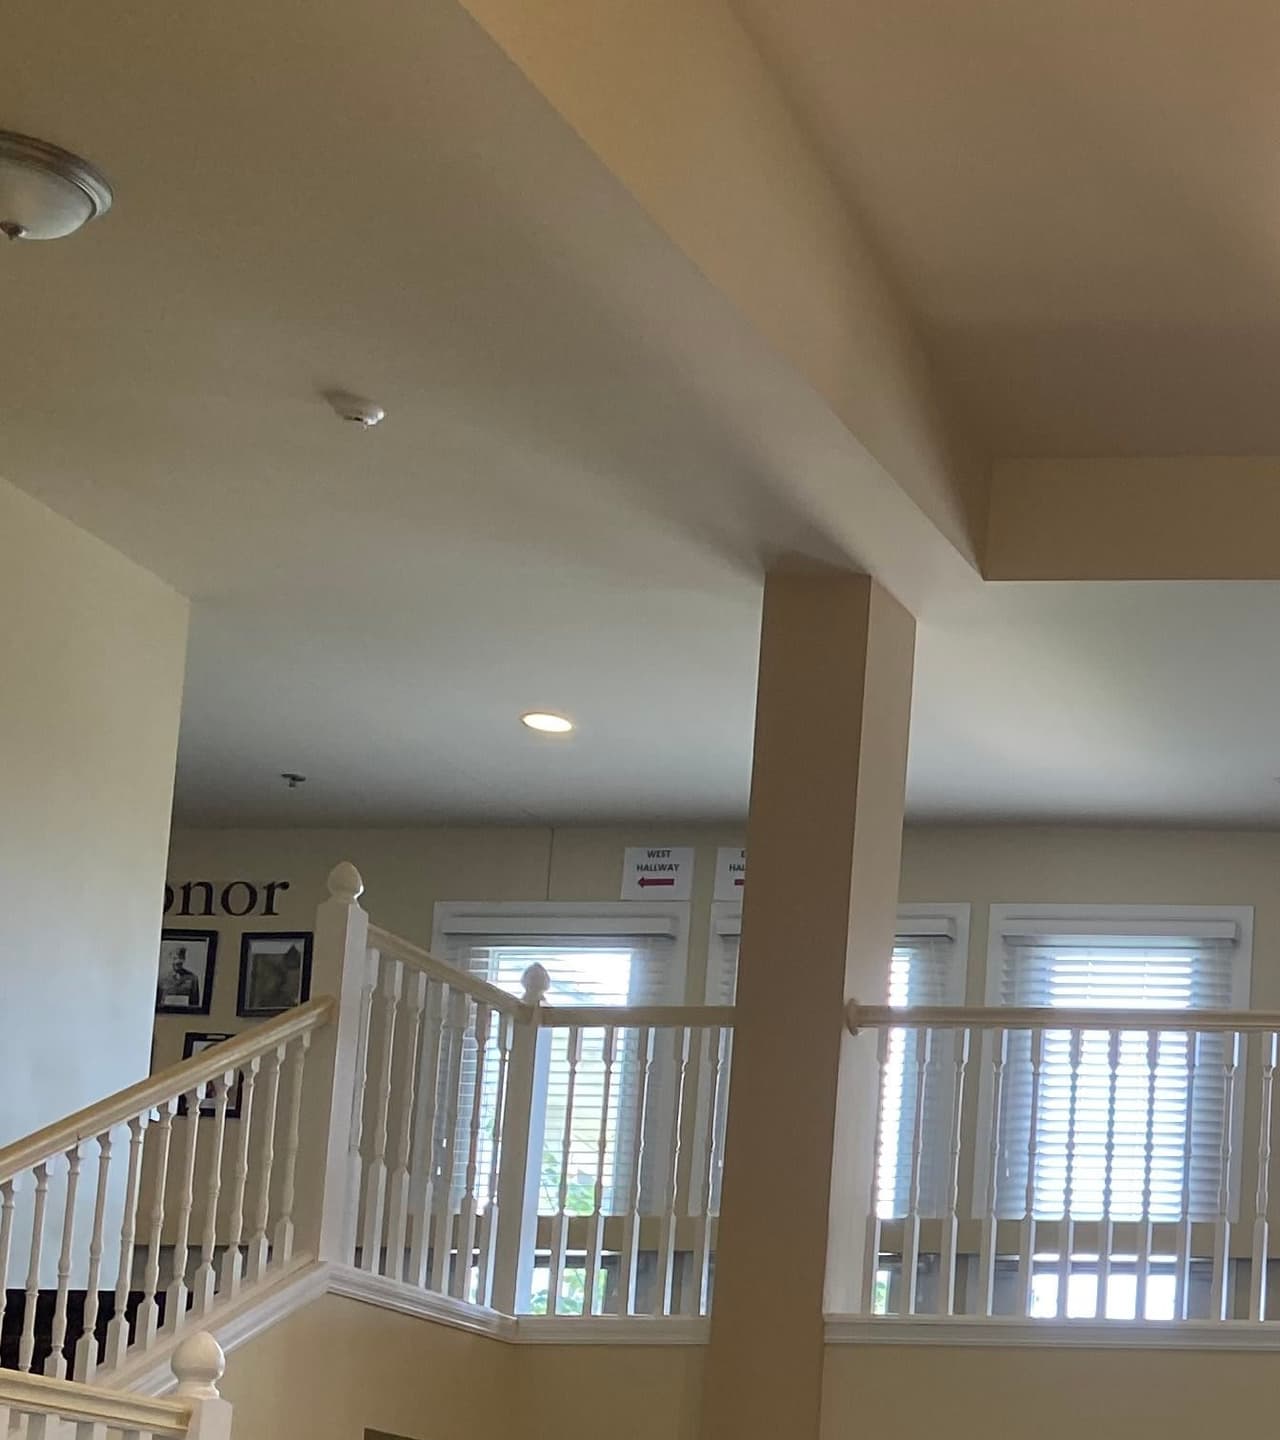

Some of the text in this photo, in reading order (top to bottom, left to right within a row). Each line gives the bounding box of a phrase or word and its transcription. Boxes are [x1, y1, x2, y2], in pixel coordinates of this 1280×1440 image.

[647, 850, 671, 859] WEST
[636, 863, 680, 872] HALLWAY
[164, 881, 290, 916] nor
